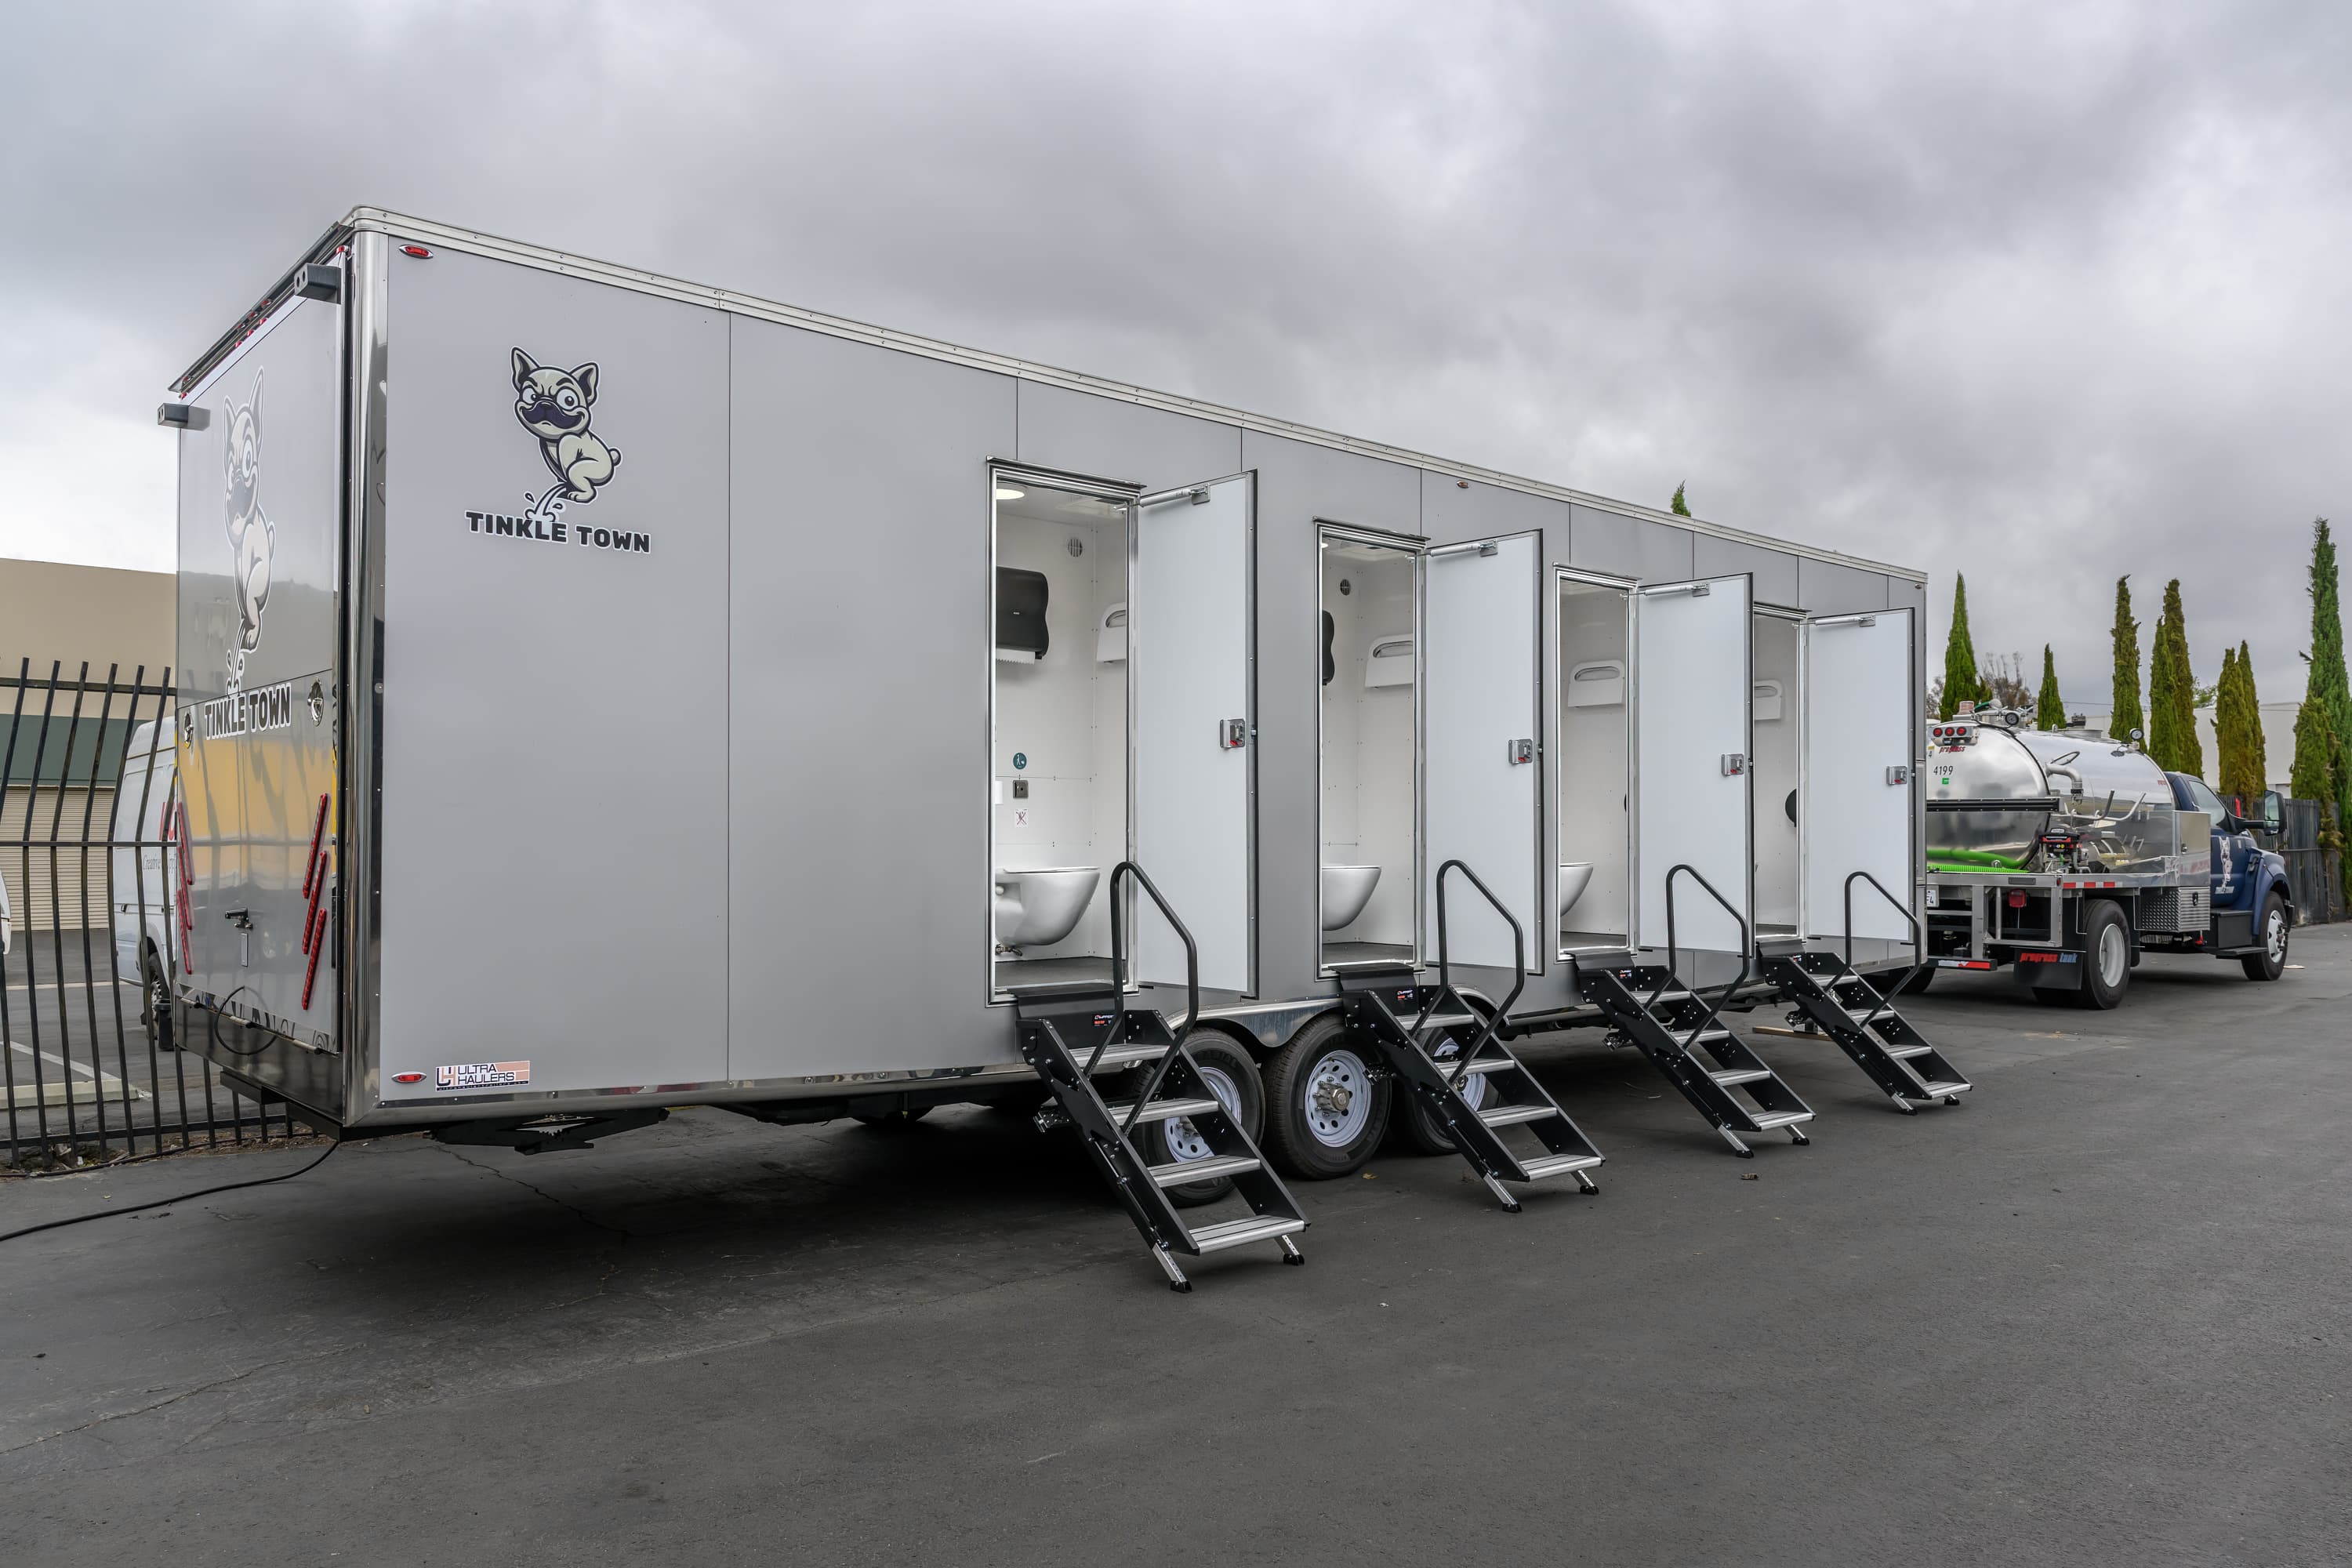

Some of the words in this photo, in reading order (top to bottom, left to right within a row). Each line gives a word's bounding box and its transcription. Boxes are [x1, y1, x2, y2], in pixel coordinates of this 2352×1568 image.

[465, 510, 568, 543] TINKLE
[575, 524, 651, 554] TOWN
[205, 695, 245, 739] TINKLE
[249, 684, 290, 732] TOWN
[1933, 766, 1953, 775] 4199
[458, 1064, 496, 1075] ULTRA
[458, 1072, 514, 1085] HAULERS
